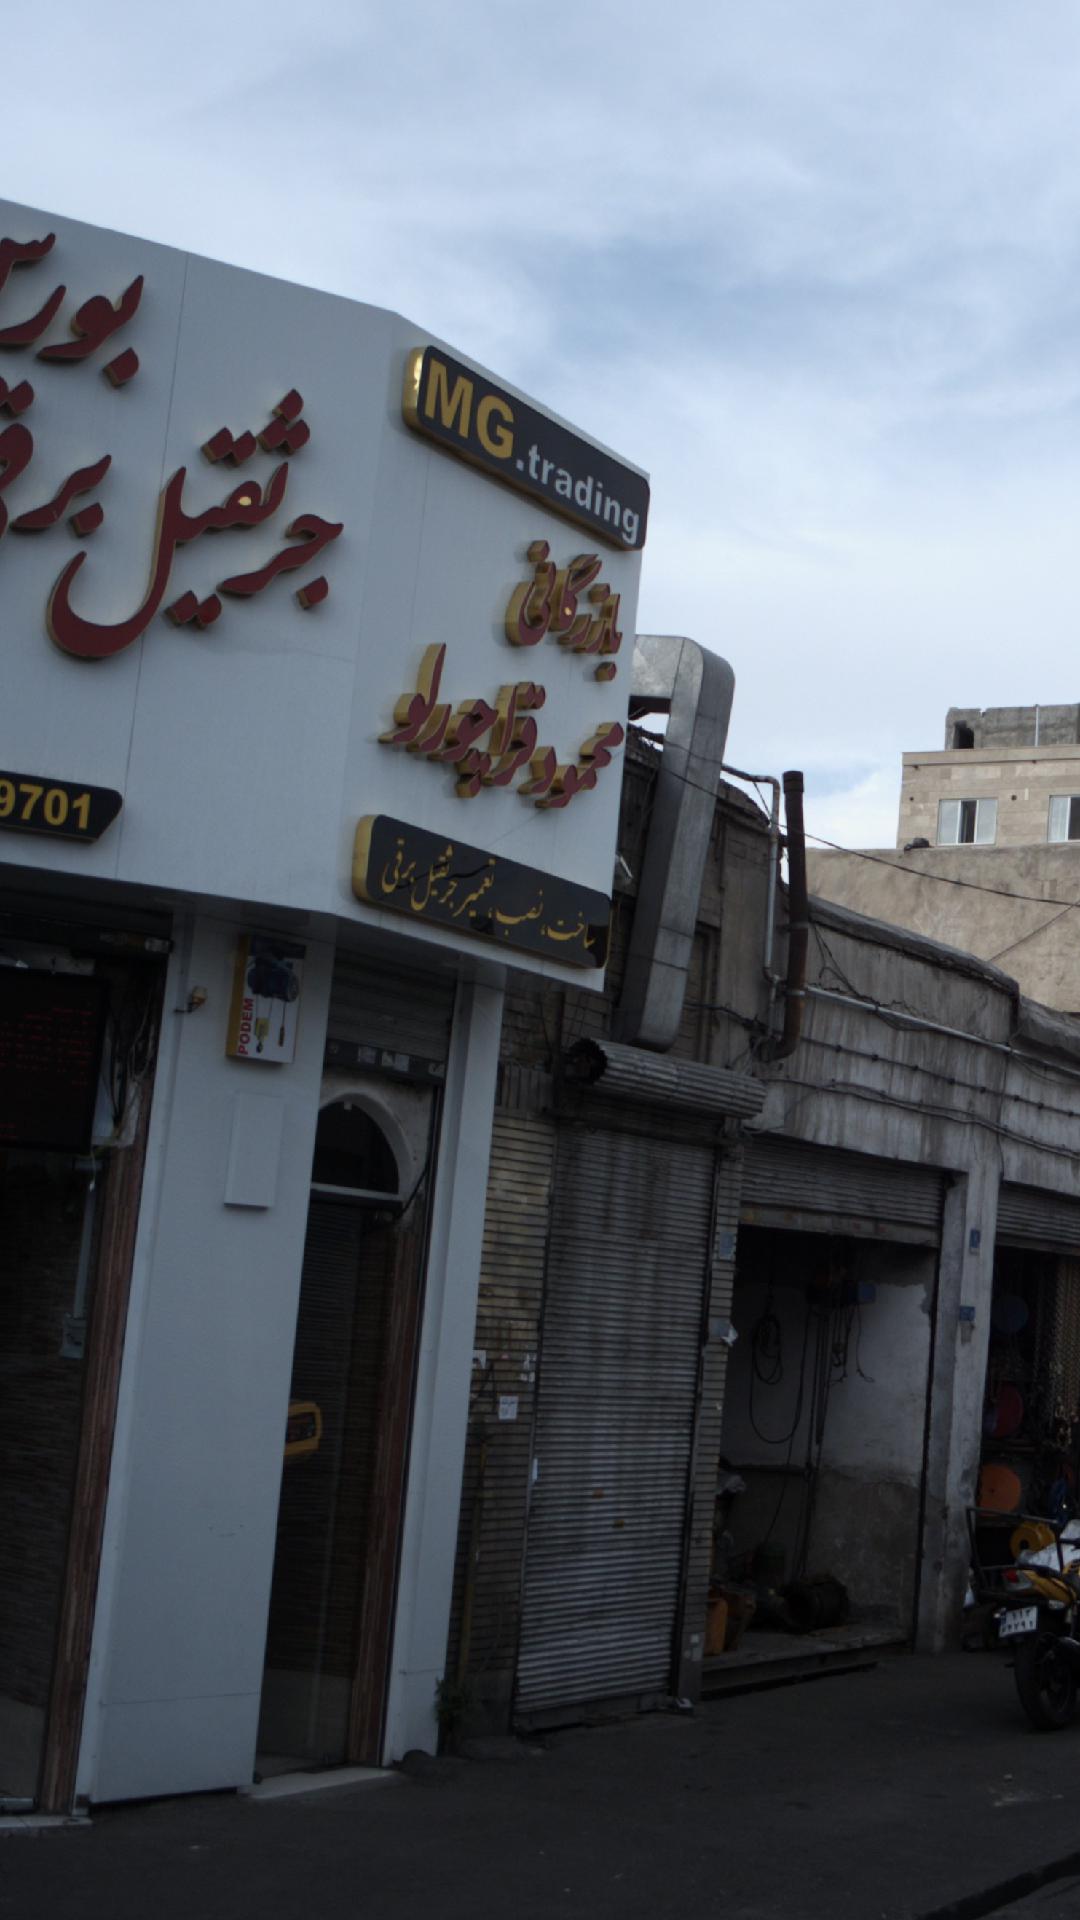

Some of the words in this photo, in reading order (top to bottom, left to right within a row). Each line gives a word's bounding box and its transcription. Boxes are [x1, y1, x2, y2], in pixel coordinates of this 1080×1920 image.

[47, 388, 344, 658] جرثقیل
[505, 540, 623, 682] بازرگانی
[0, 777, 92, 831] 9701
[517, 721, 624, 809] محمود
[238, 998, 254, 1056] PODEM
